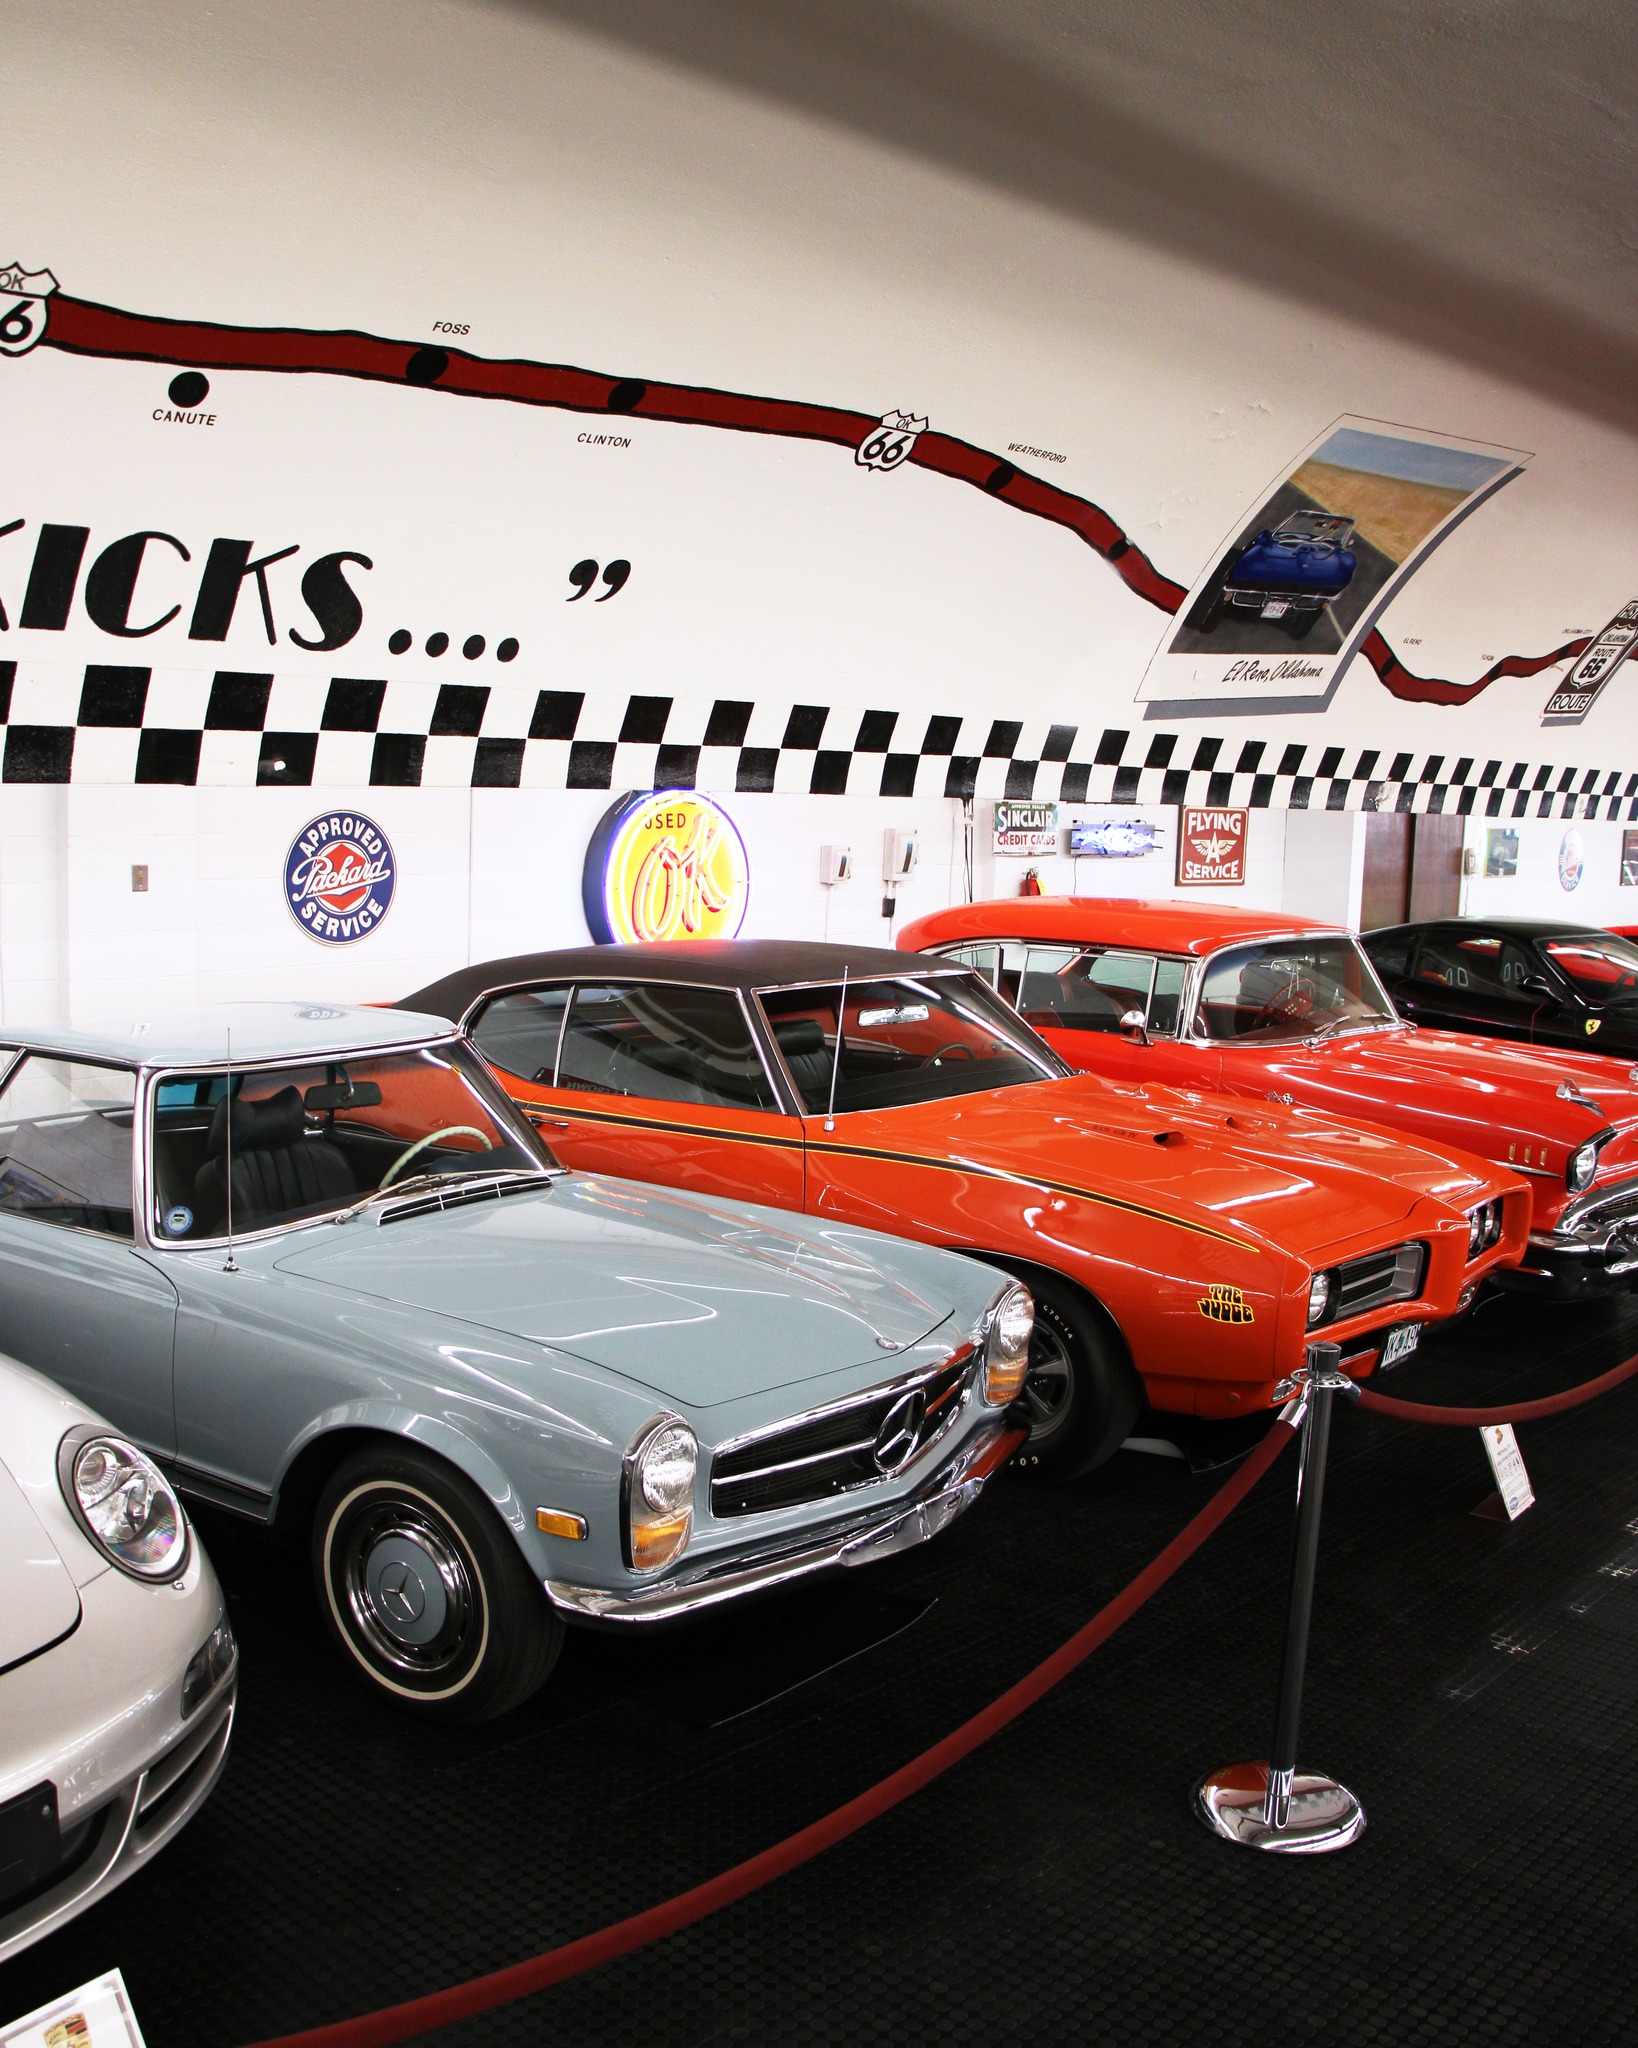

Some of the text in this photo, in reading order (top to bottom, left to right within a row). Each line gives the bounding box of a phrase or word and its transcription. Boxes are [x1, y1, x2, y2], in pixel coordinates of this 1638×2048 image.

[0, 272, 26, 291] OK
[432, 321, 471, 336] FOSS
[152, 409, 218, 426] CANUTE
[895, 418, 912, 430] OK
[577, 433, 632, 449] CLINTON
[862, 431, 912, 463] 66
[1007, 442, 1067, 464] WEATHERFORD
[1409, 638, 1423, 646] RENO
[1593, 648, 1617, 658] ROUTE
[1222, 660, 1324, 683] El Reno, Oklahoma
[1578, 658, 1608, 678] 66
[1550, 694, 1591, 710] ROUTE
[644, 813, 686, 830] USED
[997, 806, 1055, 833] SINCLAIR
[1187, 812, 1242, 836] FLYING
[299, 817, 383, 858] APPROVED
[997, 834, 1028, 846] CREDIT
[292, 851, 391, 902] Packard
[1186, 859, 1239, 879] SERVICE
[301, 897, 384, 938] SERVICE
[1209, 1283, 1243, 1304] THE
[1197, 1298, 1255, 1325] JUDGE
